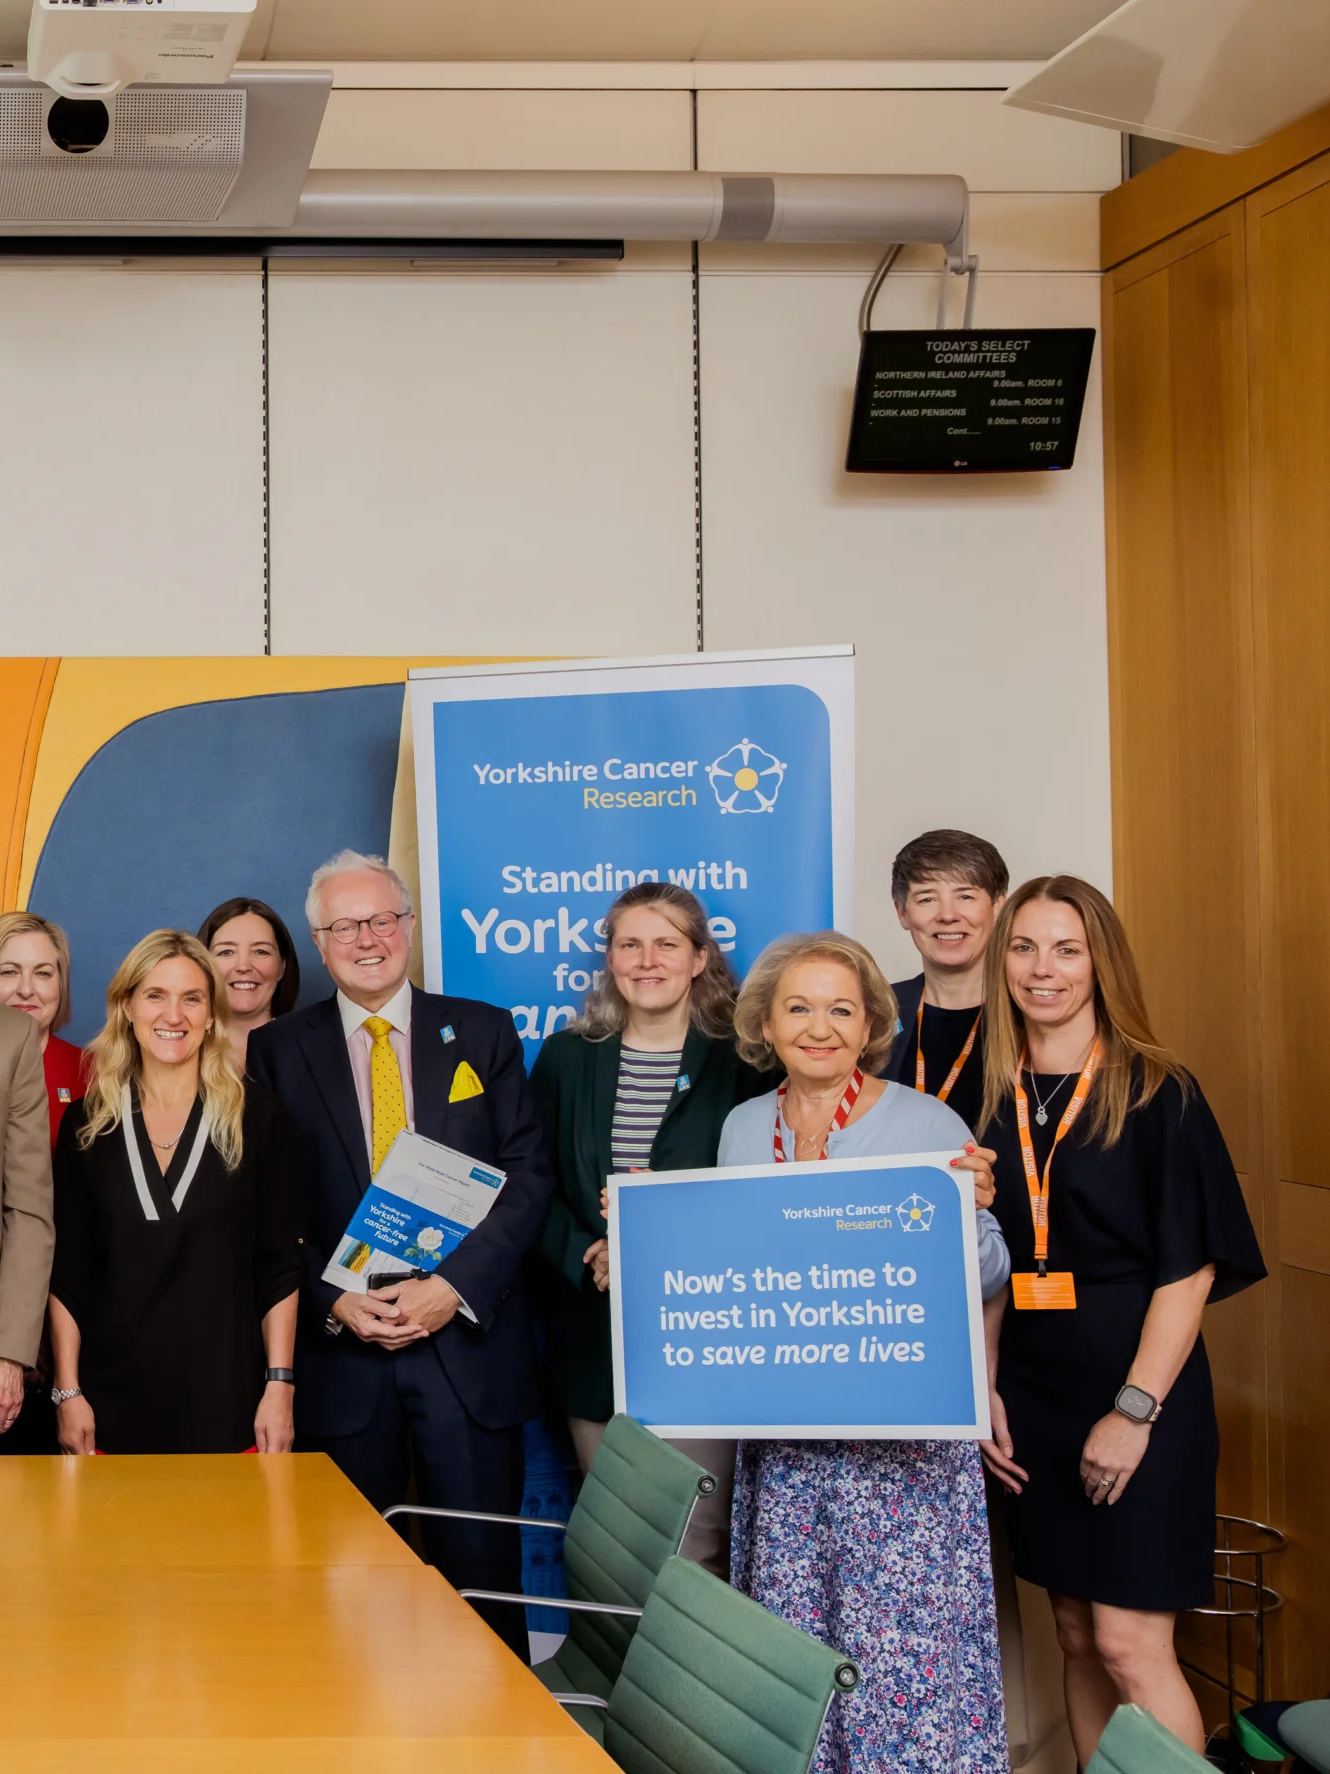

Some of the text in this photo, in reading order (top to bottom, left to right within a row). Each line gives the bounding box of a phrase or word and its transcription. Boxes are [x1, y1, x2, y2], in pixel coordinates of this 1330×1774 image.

[926, 340, 1030, 351] TODAY'S SELECT
[935, 352, 1017, 363] COMMITTEES
[875, 370, 1006, 380] NORTHERN IRELAND AFFAIRS
[873, 390, 957, 399] SCOTTISH AFFAIRS
[1024, 398, 1052, 406] ROOM
[870, 408, 966, 417] WORK AND PENSIONS
[1029, 441, 1059, 451] 10:57
[474, 758, 698, 786] Yorkshire Cancer
[583, 784, 697, 810] Research
[668, 860, 747, 891] with
[943, 1068, 960, 1091] VISITOR
[1018, 1099, 1027, 1128] VISITOR
[1063, 1096, 1082, 1125] VISITOR
[1023, 1146, 1035, 1176] VISITOR
[370, 1204, 405, 1226] Yorkshire
[379, 1202, 411, 1220] Standing with
[782, 1204, 892, 1220] Yorkshire Cancer
[364, 1218, 408, 1241] cancer-free
[836, 1217, 892, 1232] Research
[374, 1231, 399, 1246] future
[664, 1262, 917, 1296] Now's the time to
[660, 1298, 925, 1331] invest in Yorkshire
[663, 1335, 925, 1366] to save more lives
